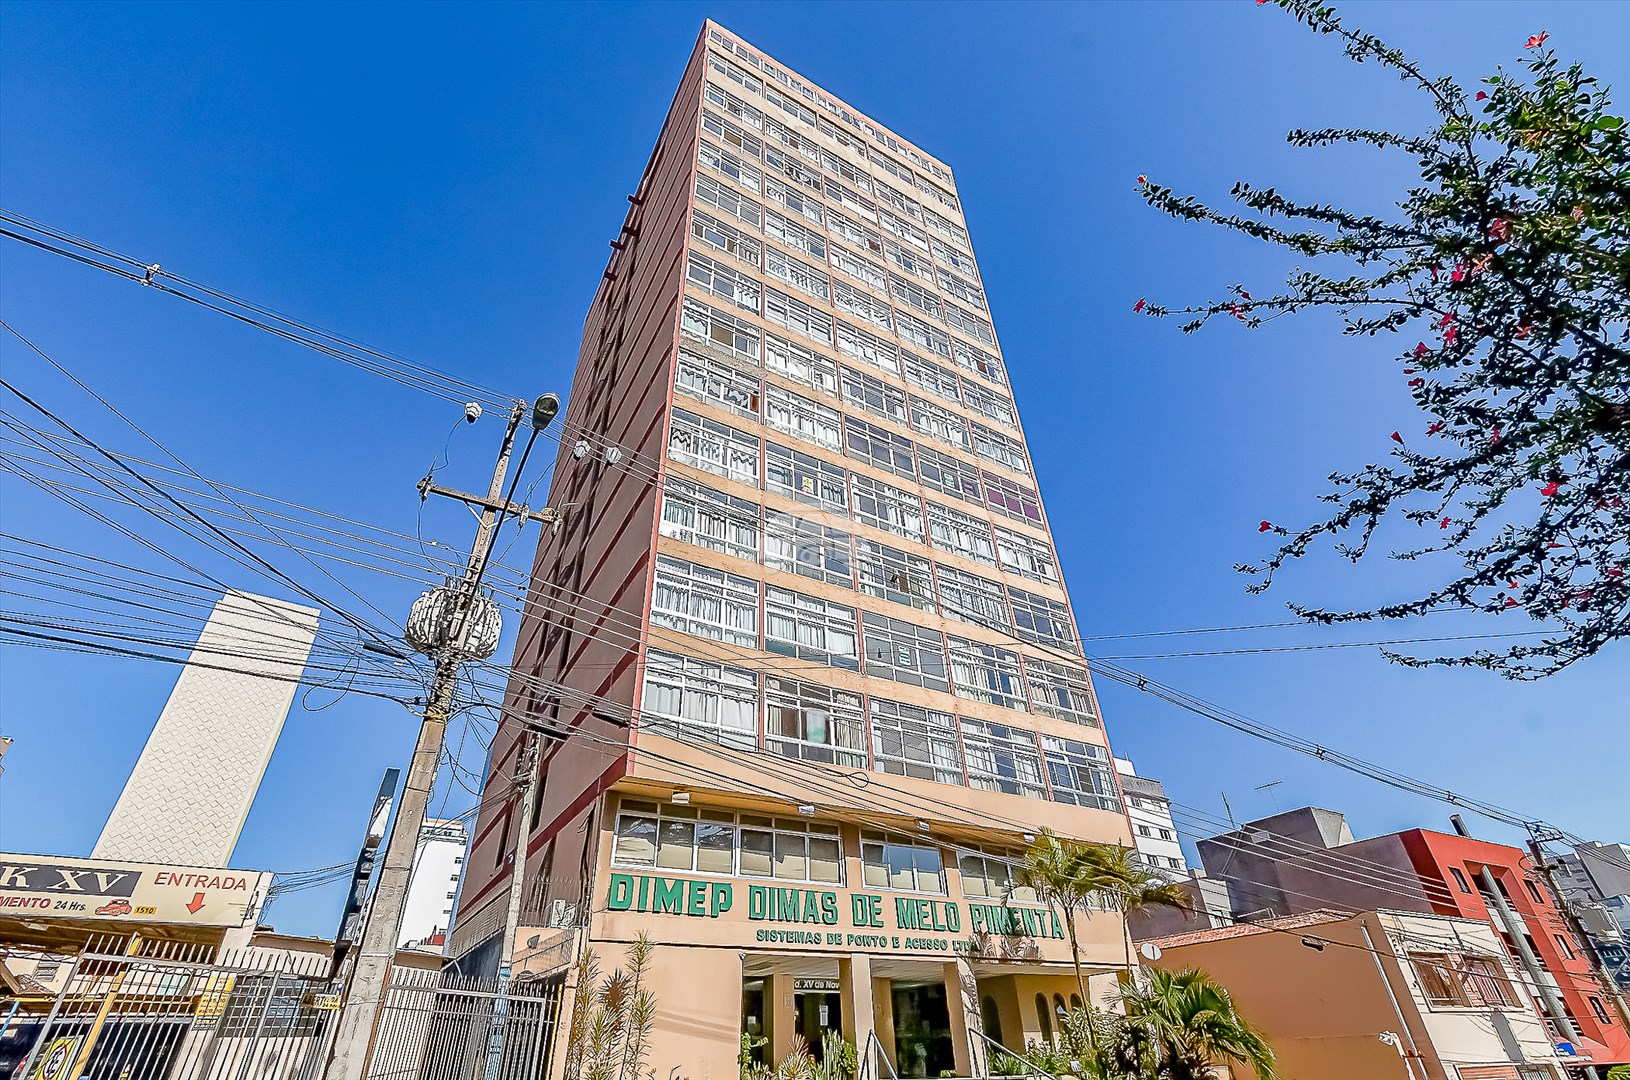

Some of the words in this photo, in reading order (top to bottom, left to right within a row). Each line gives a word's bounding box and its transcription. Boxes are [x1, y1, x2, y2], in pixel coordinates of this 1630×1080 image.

[46, 869, 128, 892] XV
[154, 872, 246, 891] ENTRADA
[54, 900, 68, 910] 24
[68, 901, 87, 911] Hrs.
[135, 906, 153, 914] 1510
[608, 873, 733, 918] DIMEP
[748, 885, 838, 925] DIMAS
[850, 893, 884, 927] DE
[894, 897, 960, 932] MELO
[969, 903, 1065, 940] PIMENTA
[756, 929, 822, 944] SISTEMAS
[826, 932, 843, 945] DE
[847, 933, 887, 948] PONTO
[892, 936, 900, 948] E
[905, 936, 948, 951] ACESSO
[803, 980, 813, 988] XV
[814, 980, 824, 988] de
